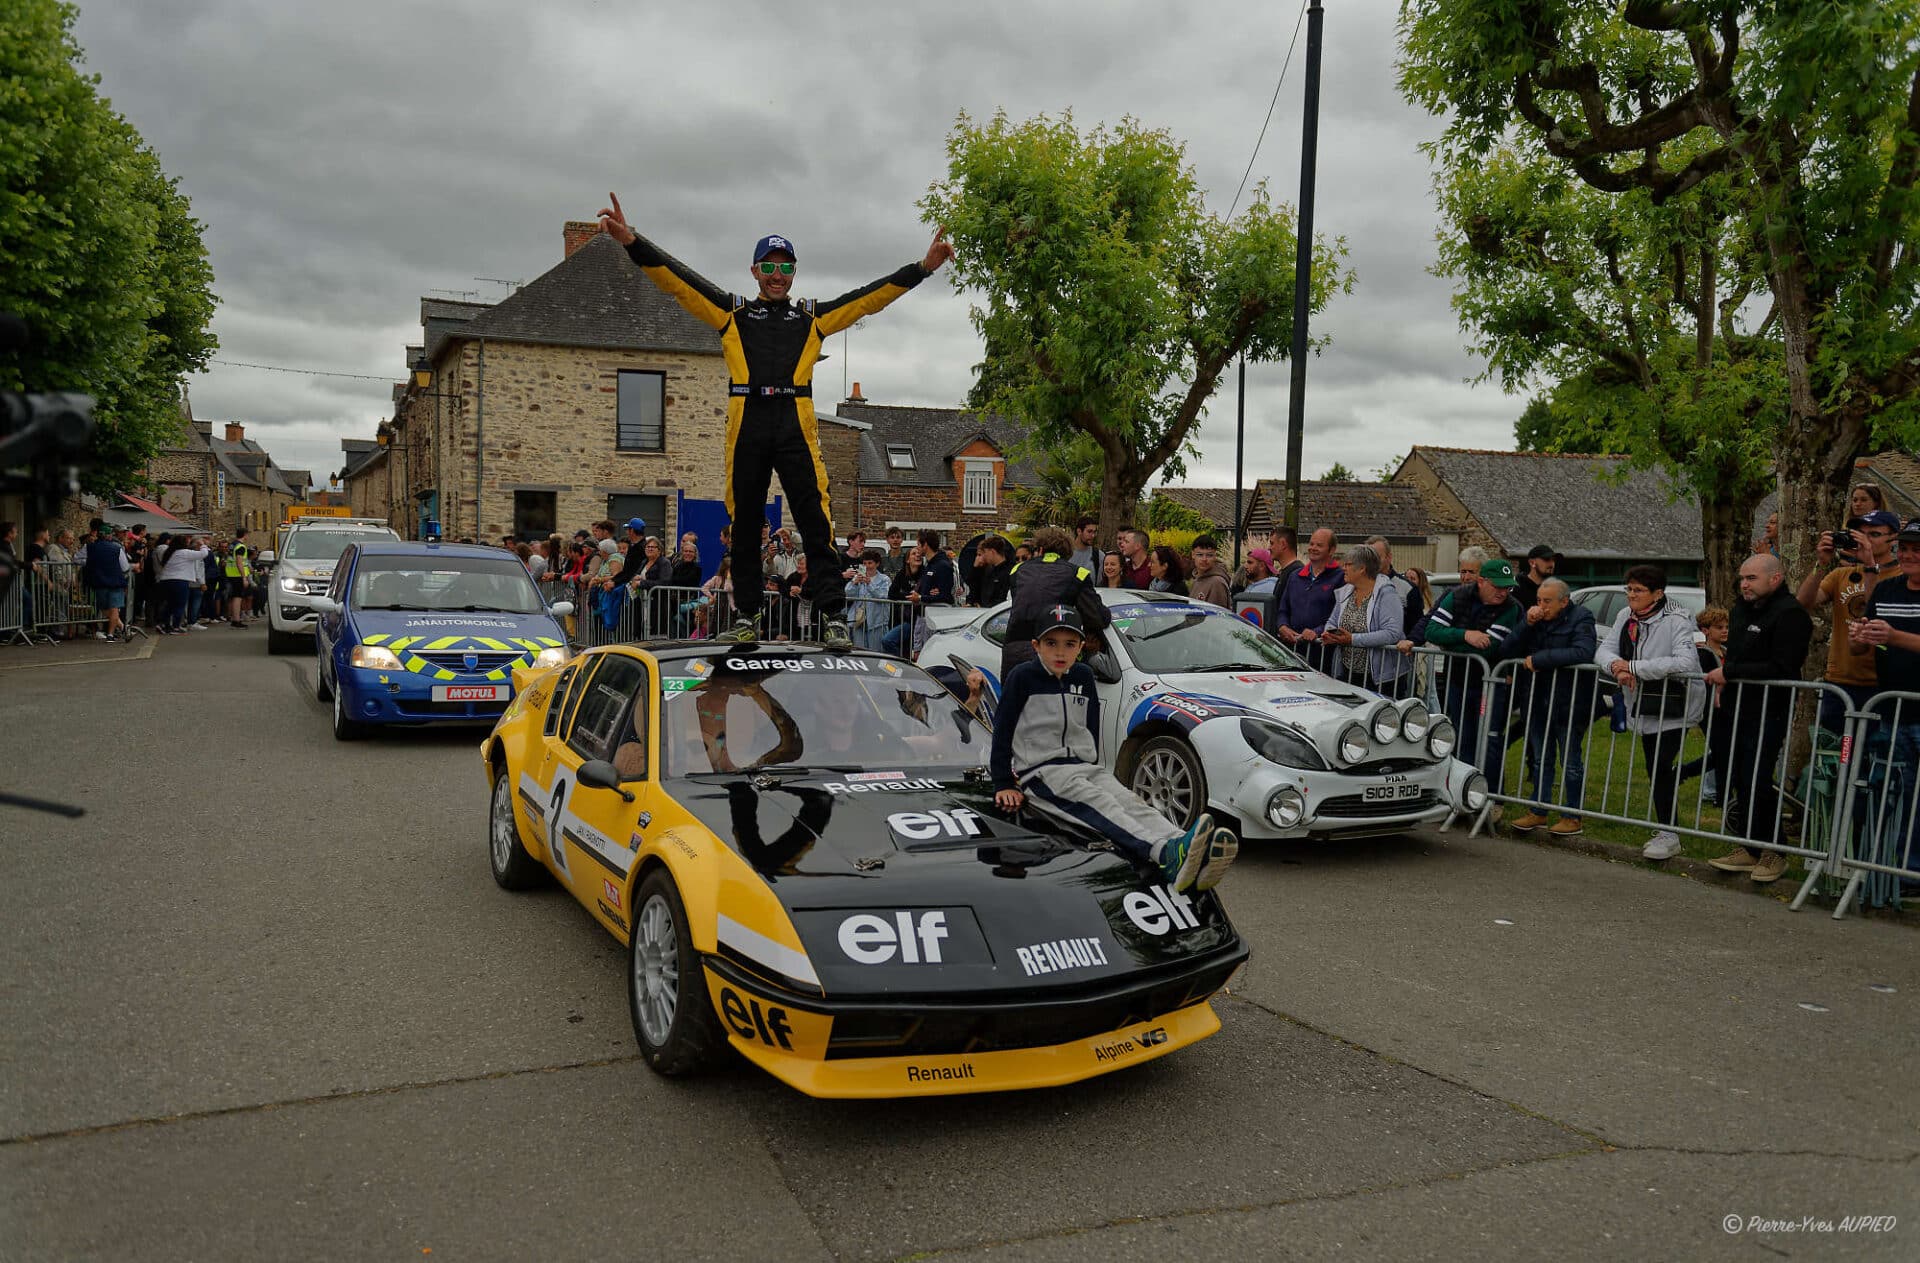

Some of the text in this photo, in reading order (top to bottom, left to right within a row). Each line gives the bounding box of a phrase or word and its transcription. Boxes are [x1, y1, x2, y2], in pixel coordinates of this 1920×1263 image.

[305, 507, 335, 516] CONVOI
[405, 618, 518, 629] JANAUTOMOBILES
[726, 656, 870, 672] Garage JAN
[448, 688, 494, 699] MOTUL
[668, 680, 685, 691] 23
[1158, 694, 1209, 717] FERODO
[823, 777, 946, 795] Renault
[1384, 775, 1408, 783] PIAA
[1366, 783, 1420, 801] S103 RDB
[551, 778, 567, 870] 2
[887, 807, 982, 840] elf
[1122, 883, 1201, 936] elf
[837, 911, 949, 965] elf
[1016, 937, 1109, 976] RENAULT
[720, 986, 794, 1051] elf
[1095, 1038, 1134, 1062] Alpine
[907, 1062, 976, 1083] Renault
